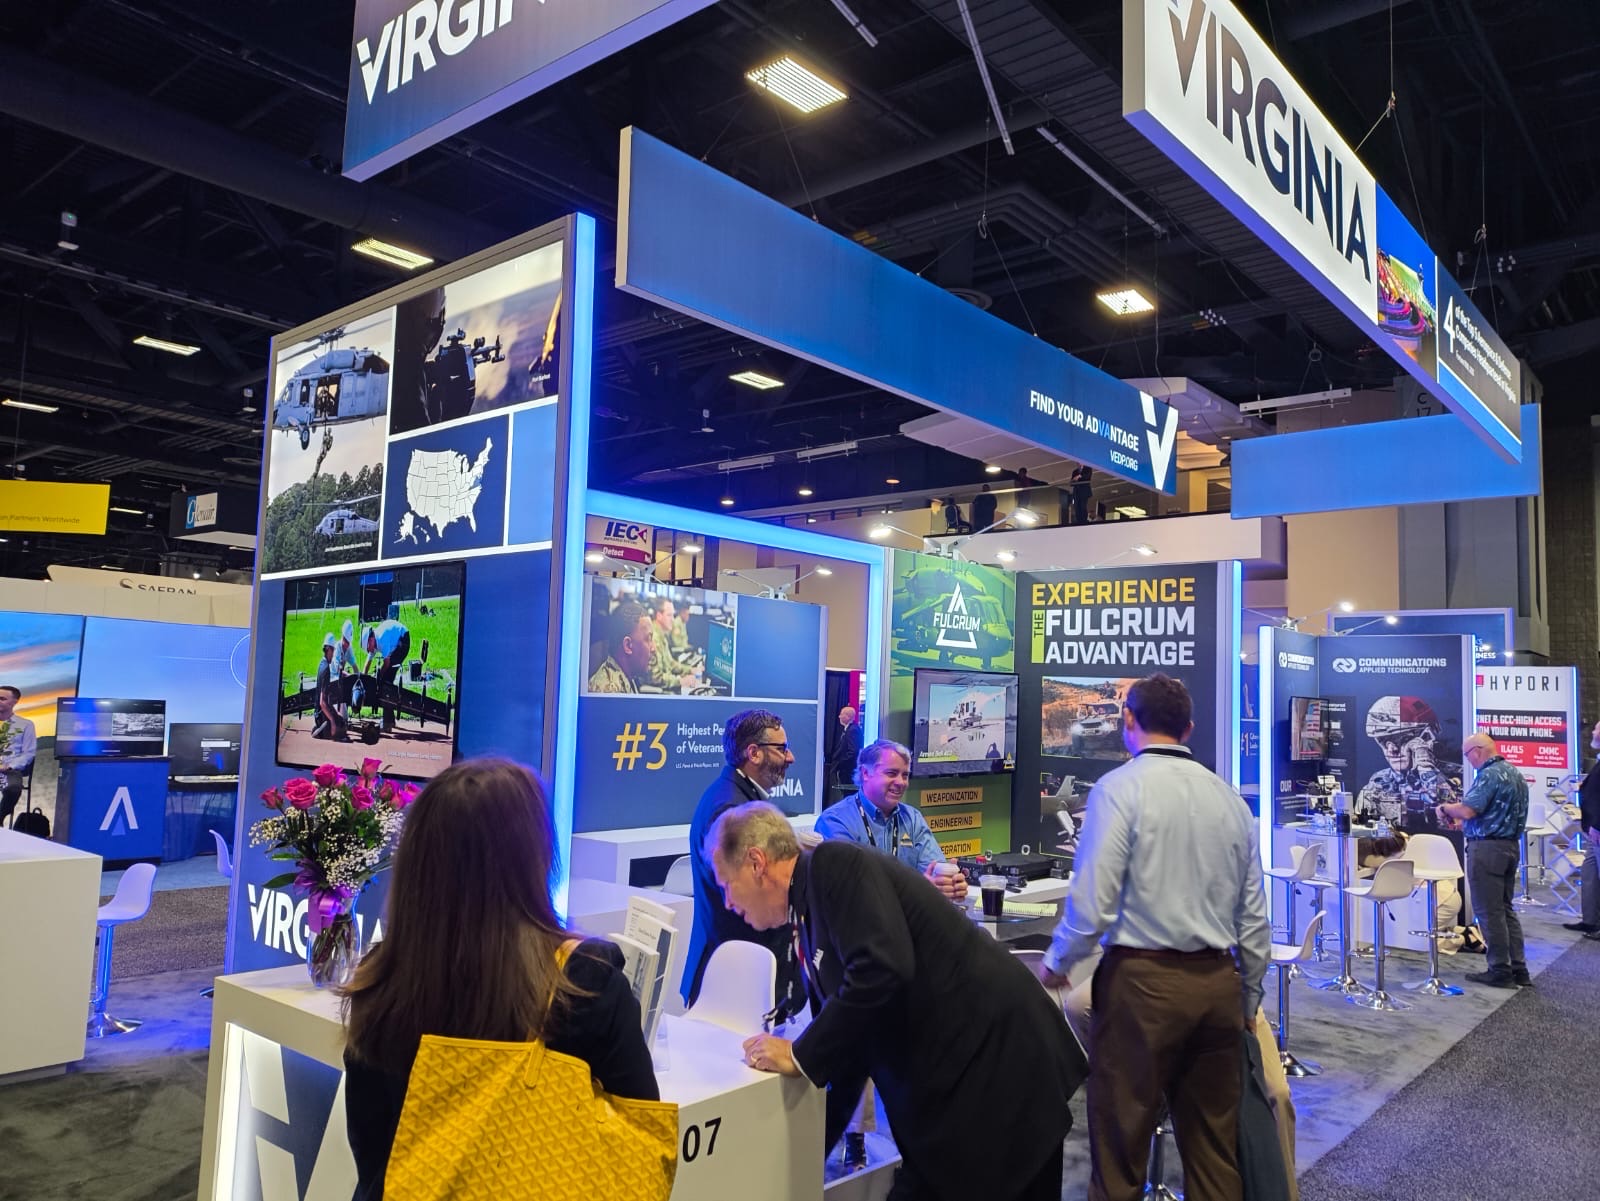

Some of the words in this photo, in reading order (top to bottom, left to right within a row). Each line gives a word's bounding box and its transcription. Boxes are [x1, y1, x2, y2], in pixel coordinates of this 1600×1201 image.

[356, 0, 546, 105] VIRG
[1167, 0, 1371, 284] VIRGINIA
[1443, 295, 1456, 353] 4
[1417, 392, 1428, 404] C
[1030, 390, 1055, 415] FIND
[1056, 401, 1083, 428] YOUR
[1085, 414, 1139, 452] ADVANTAGE
[1110, 450, 1139, 471] VEDP.ORG
[605, 521, 640, 541] IEC
[602, 547, 624, 557] Detect
[1032, 578, 1196, 606] EXPERIENCE
[933, 612, 981, 632] FULCRUM
[1033, 613, 1044, 638] THE
[1046, 606, 1195, 636] FULCRUM
[1045, 641, 1195, 666] ADVANTAGE
[1359, 658, 1447, 667] COMMUNICATIONS
[1490, 675, 1559, 691] HYPORI
[677, 723, 710, 738] Highest
[1500, 716, 1533, 726] GCC-HIGH
[1535, 716, 1562, 726] ACCESS
[1491, 727, 1509, 736] YOUR
[1510, 727, 1528, 737] OWN
[1529, 728, 1555, 738] PHONE.
[612, 723, 669, 771] #3
[676, 741, 686, 753] of
[688, 741, 724, 753] Veterans
[1538, 747, 1560, 756] CMMC
[769, 779, 803, 798] GINIA
[1280, 780, 1292, 792] OUR
[926, 791, 978, 803] WEAPONIZATION
[930, 816, 973, 829] ENGINEERING
[941, 843, 972, 855] EGRATION
[247, 883, 384, 960] VIRGI
[682, 1117, 722, 1163] 07
